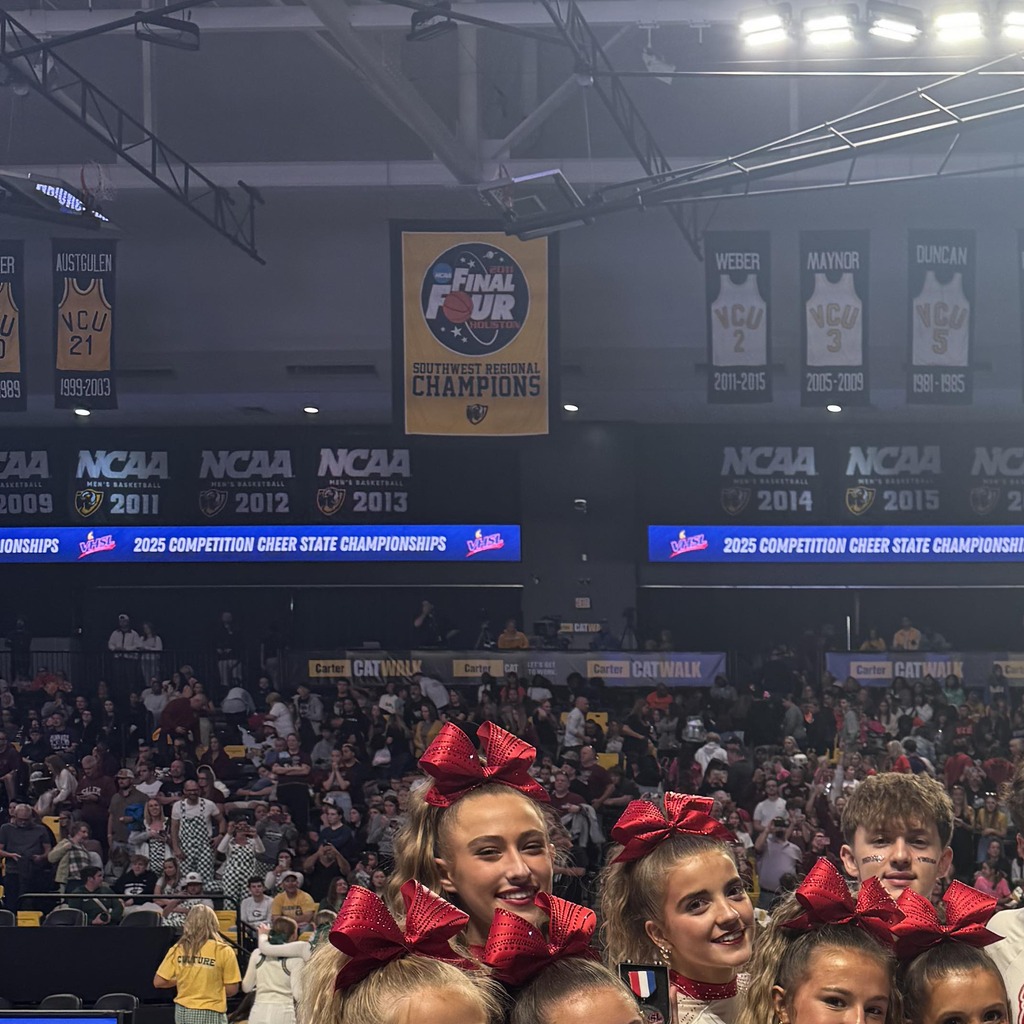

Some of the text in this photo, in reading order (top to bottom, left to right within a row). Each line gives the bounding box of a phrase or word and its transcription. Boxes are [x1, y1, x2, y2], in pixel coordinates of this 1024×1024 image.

[56, 253, 112, 272] AUSTGULEN
[715, 253, 760, 270] WEBER
[807, 251, 860, 270] MAYNOR
[916, 245, 967, 265] DUNCAN
[452, 268, 515, 292] FINAL
[62, 310, 107, 332] VCU
[469, 321, 520, 329] HOUSTON
[714, 304, 763, 330] VCU
[809, 303, 859, 330] VCU
[916, 302, 969, 330] VCU
[70, 335, 92, 355] 21
[733, 329, 745, 353] 2
[826, 329, 842, 353] 3
[931, 329, 949, 355] 5
[412, 362, 541, 374] SOUTHWEST REGIONAL
[60, 378, 111, 397] 1999-2003
[412, 375, 541, 397] CHAMPIONS
[714, 373, 766, 391] 2011-2015
[806, 373, 864, 392] 2005-2009
[913, 374, 965, 393] 1981-1985
[75, 450, 169, 479] NCAA
[199, 450, 294, 479] NCAA
[317, 448, 411, 477] NCAA
[720, 446, 817, 476] NCAA
[845, 446, 941, 475] NCAA
[114, 481, 161, 489] BASKETBALL
[110, 493, 158, 515] 2011
[235, 493, 289, 513] 2012
[353, 491, 408, 513] 2013
[758, 490, 813, 511] 2014
[883, 490, 940, 511] 2015
[79, 535, 114, 553] VHSL
[133, 536, 447, 553] 2025 COMPETITION CHEER STATE CHAMPIONSHIPS
[467, 533, 502, 551] VHSL
[723, 538, 757, 553] 2025
[759, 537, 847, 553] COMPETITION
[849, 538, 891, 553] CHEER
[892, 538, 931, 553] STATE
[315, 660, 422, 677] Carter CATWALK
[464, 663, 518, 673] Carter CAT
[593, 661, 701, 678] Carter CATWALK
[856, 662, 963, 678] Carter CATWALK
